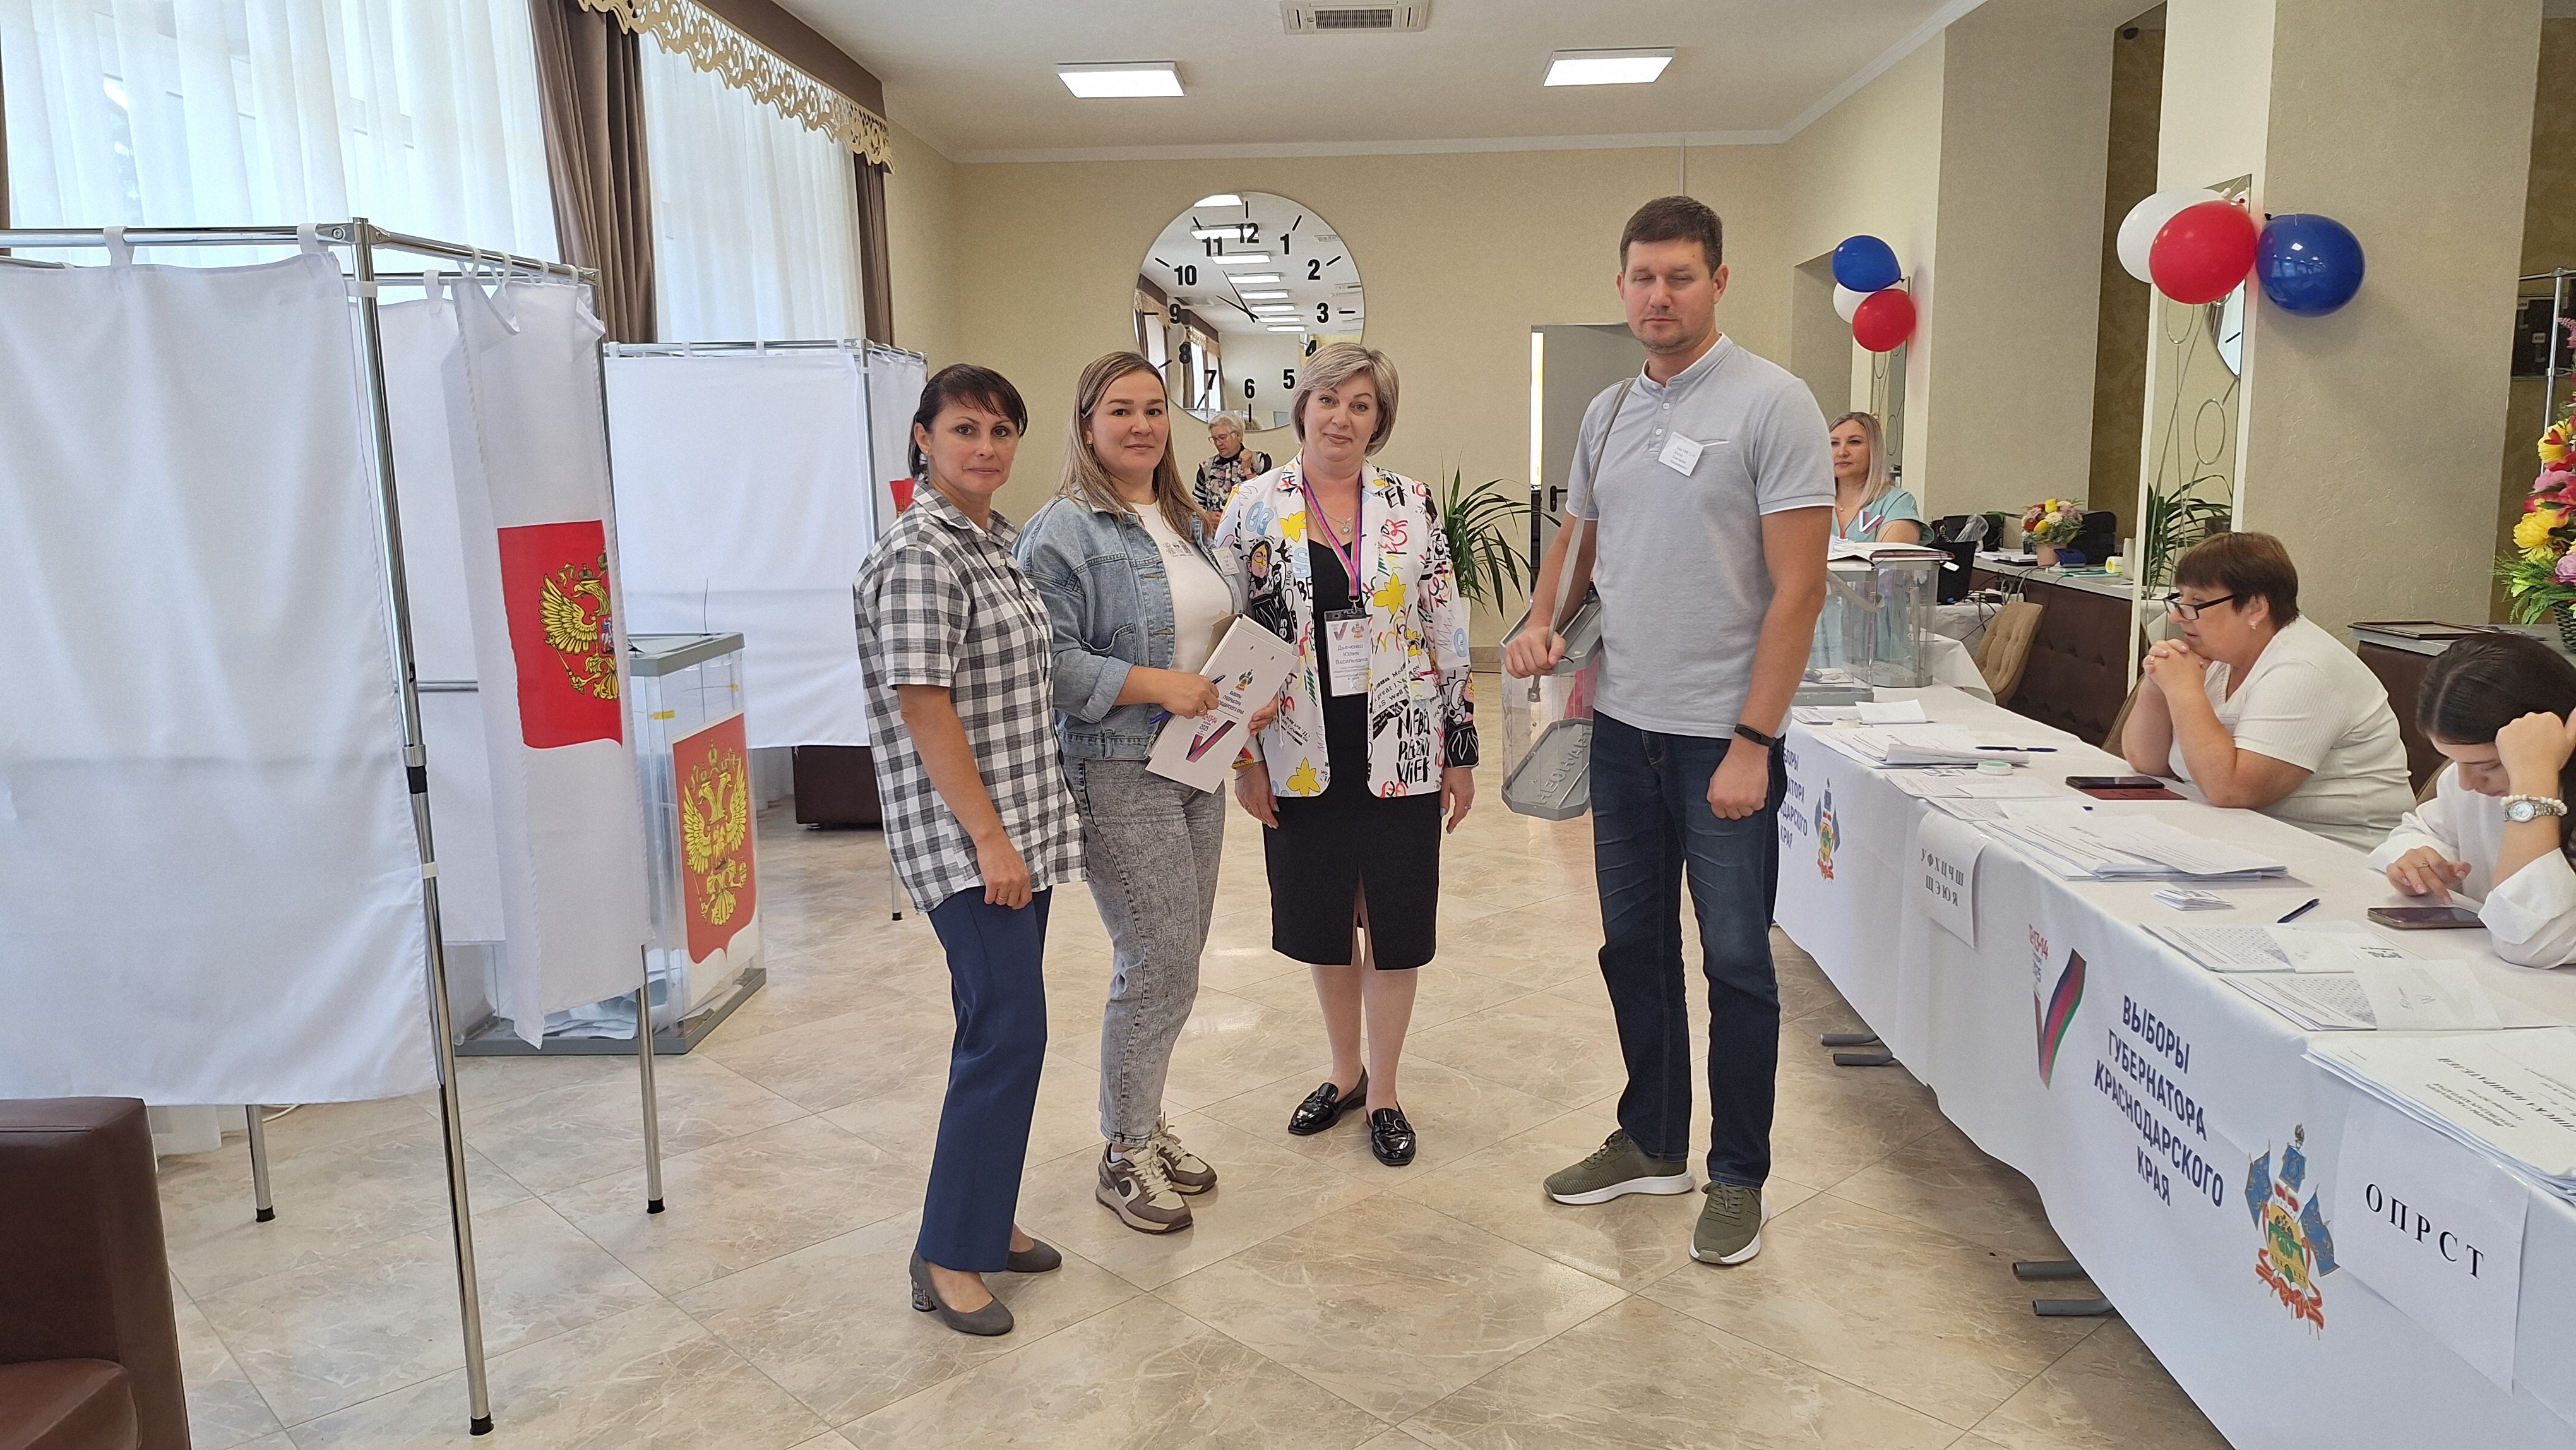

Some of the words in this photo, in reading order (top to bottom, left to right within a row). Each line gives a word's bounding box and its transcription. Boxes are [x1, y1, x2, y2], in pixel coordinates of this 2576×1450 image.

[1239, 223, 1259, 244] 12
[1202, 237, 1223, 256] 11
[1280, 234, 1289, 255] 1
[1174, 265, 1196, 285] 10
[1308, 260, 1321, 280] 2
[1169, 304, 1181, 324] 9
[1316, 303, 1329, 323] 3
[1179, 342, 1191, 364] 8
[1204, 370, 1217, 390] 7
[1244, 379, 1255, 398] 6
[1284, 369, 1296, 389] 5
[1784, 747, 1799, 772] БОРЫ
[1787, 776, 1805, 805] АТОРА
[1780, 824, 1793, 849] КРАЯ
[2122, 994, 2190, 1075] ВЫБОРЫ
[2108, 1028, 2207, 1142] ГУБЕРНАТОРА
[2094, 1059, 2224, 1207] КРАСНОДАРСКОГО
[2137, 1145, 2171, 1207] КРАЯ
